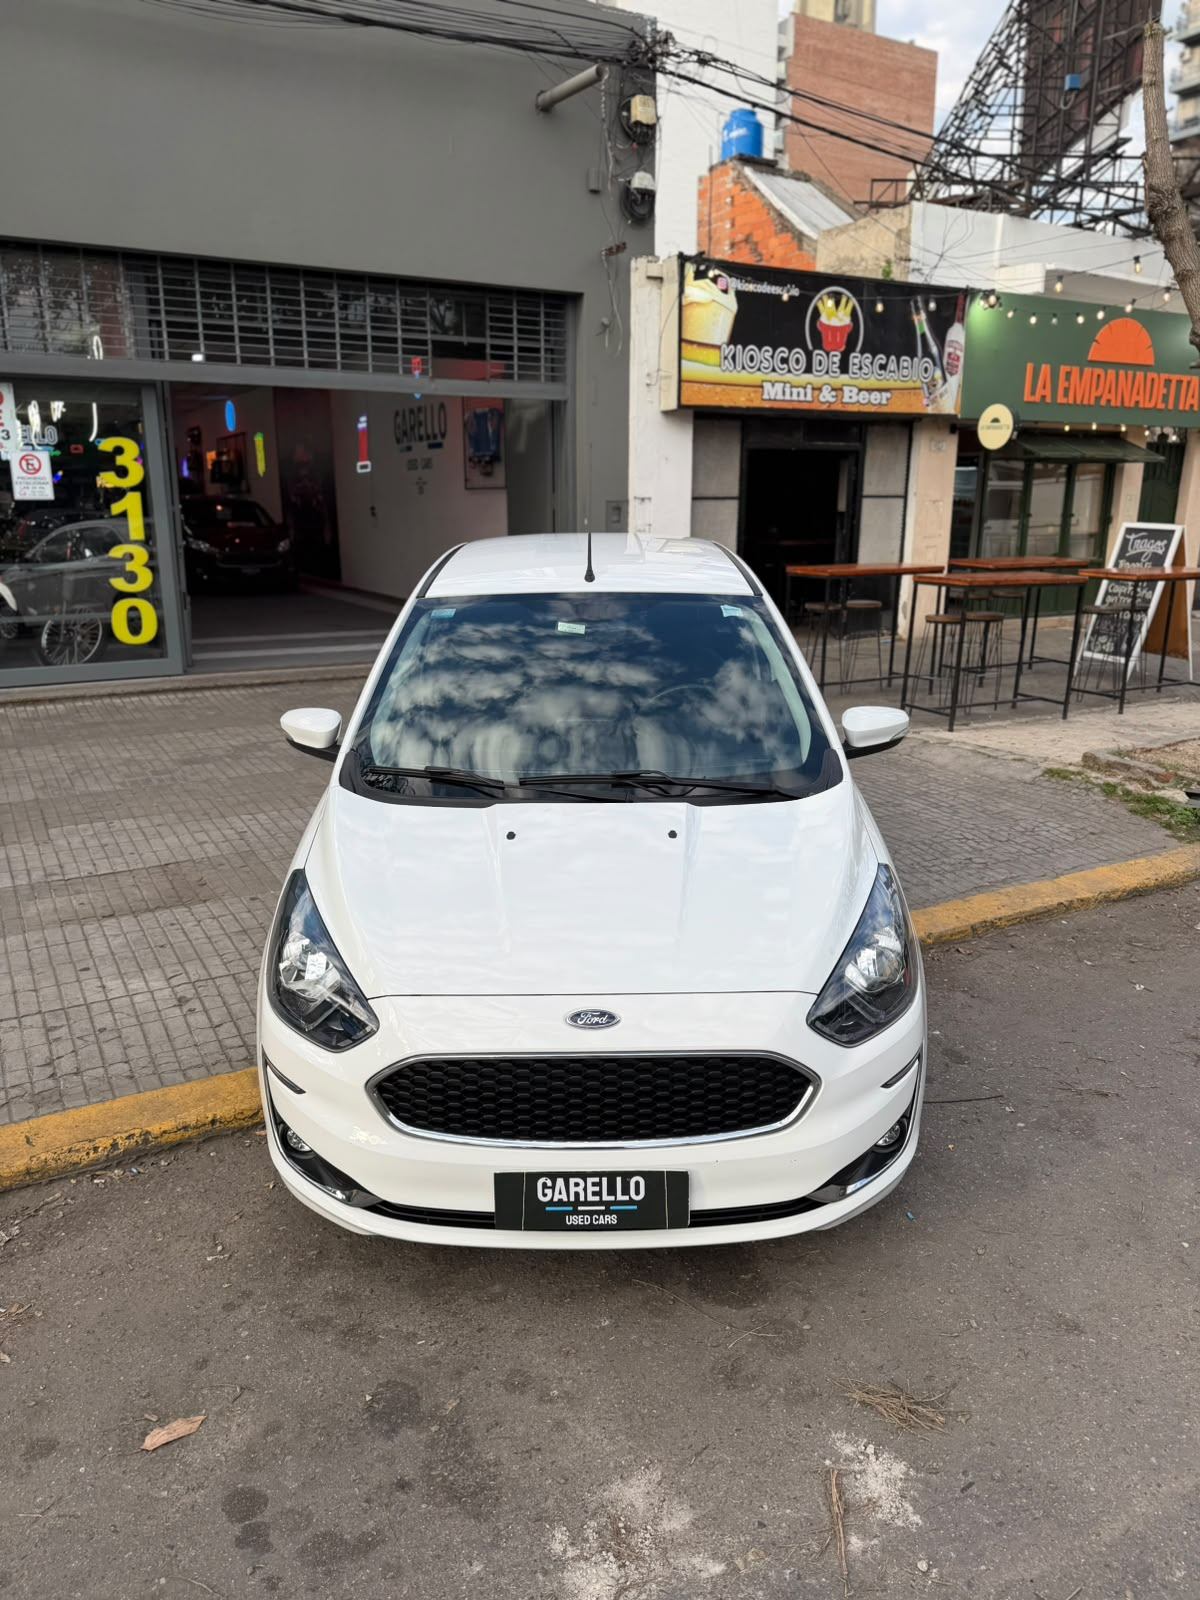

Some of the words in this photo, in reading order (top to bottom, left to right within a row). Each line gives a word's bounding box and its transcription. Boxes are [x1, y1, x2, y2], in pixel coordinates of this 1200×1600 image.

[720, 343, 806, 375] KIOSCO
[812, 350, 841, 378] DE
[849, 352, 935, 383] ESCABIO
[762, 380, 813, 402] Mini
[818, 384, 837, 404] &
[842, 384, 891, 406] Beer
[1023, 362, 1053, 404] LA
[1057, 364, 1200, 412] EMPANADETTA
[394, 402, 448, 444] GARELLO
[98, 436, 158, 646] 3130
[577, 1011, 608, 1024] Ford
[537, 1175, 645, 1202] GARELLO
[565, 1214, 590, 1225] USED
[593, 1214, 617, 1225] CARS
